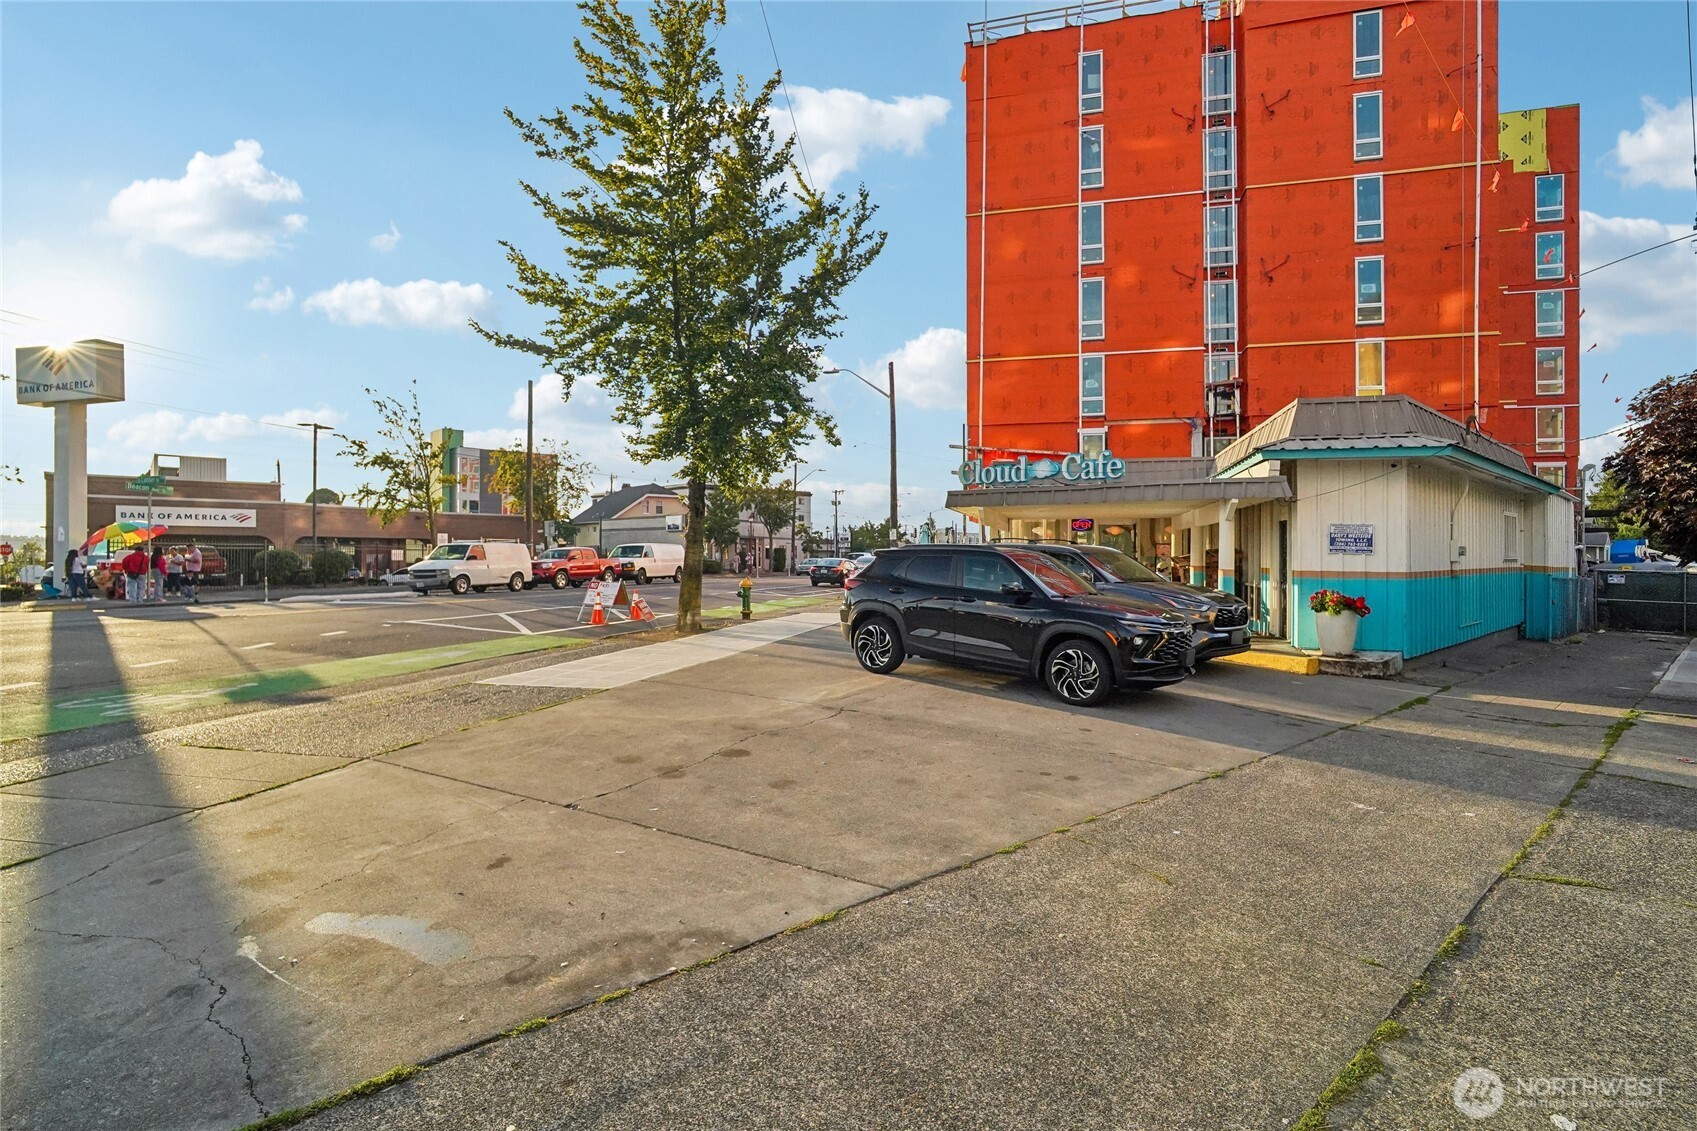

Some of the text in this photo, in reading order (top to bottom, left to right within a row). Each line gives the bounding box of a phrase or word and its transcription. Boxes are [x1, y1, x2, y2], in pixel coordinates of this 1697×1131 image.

[18, 380, 94, 395] BANK OF AMERICA
[959, 450, 1126, 485] Cloud Cafe
[127, 482, 150, 490] Beacon
[157, 512, 172, 520] OF
[176, 513, 227, 521] AMERICA
